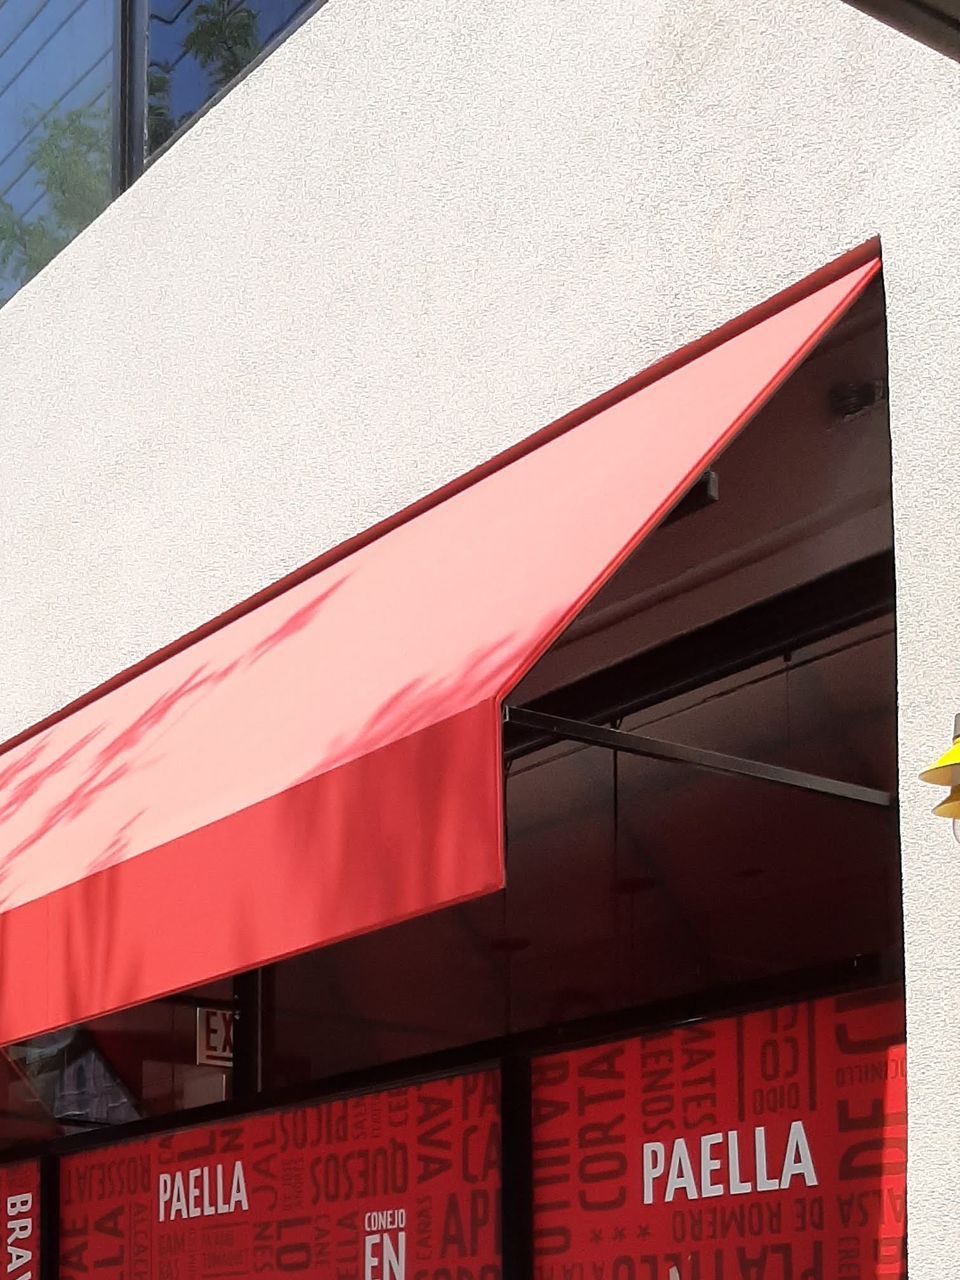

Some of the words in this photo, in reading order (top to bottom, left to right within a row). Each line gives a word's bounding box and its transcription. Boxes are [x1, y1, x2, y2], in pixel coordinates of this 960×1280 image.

[577, 1049, 627, 1212] CORTA
[642, 1119, 819, 1206] PAELLA
[157, 1159, 249, 1223] PAELLA
[309, 1138, 409, 1207] QUESOS
[364, 1208, 407, 1231] CONEJO
[671, 1201, 782, 1243] ROMERO
[792, 1196, 825, 1233] DE
